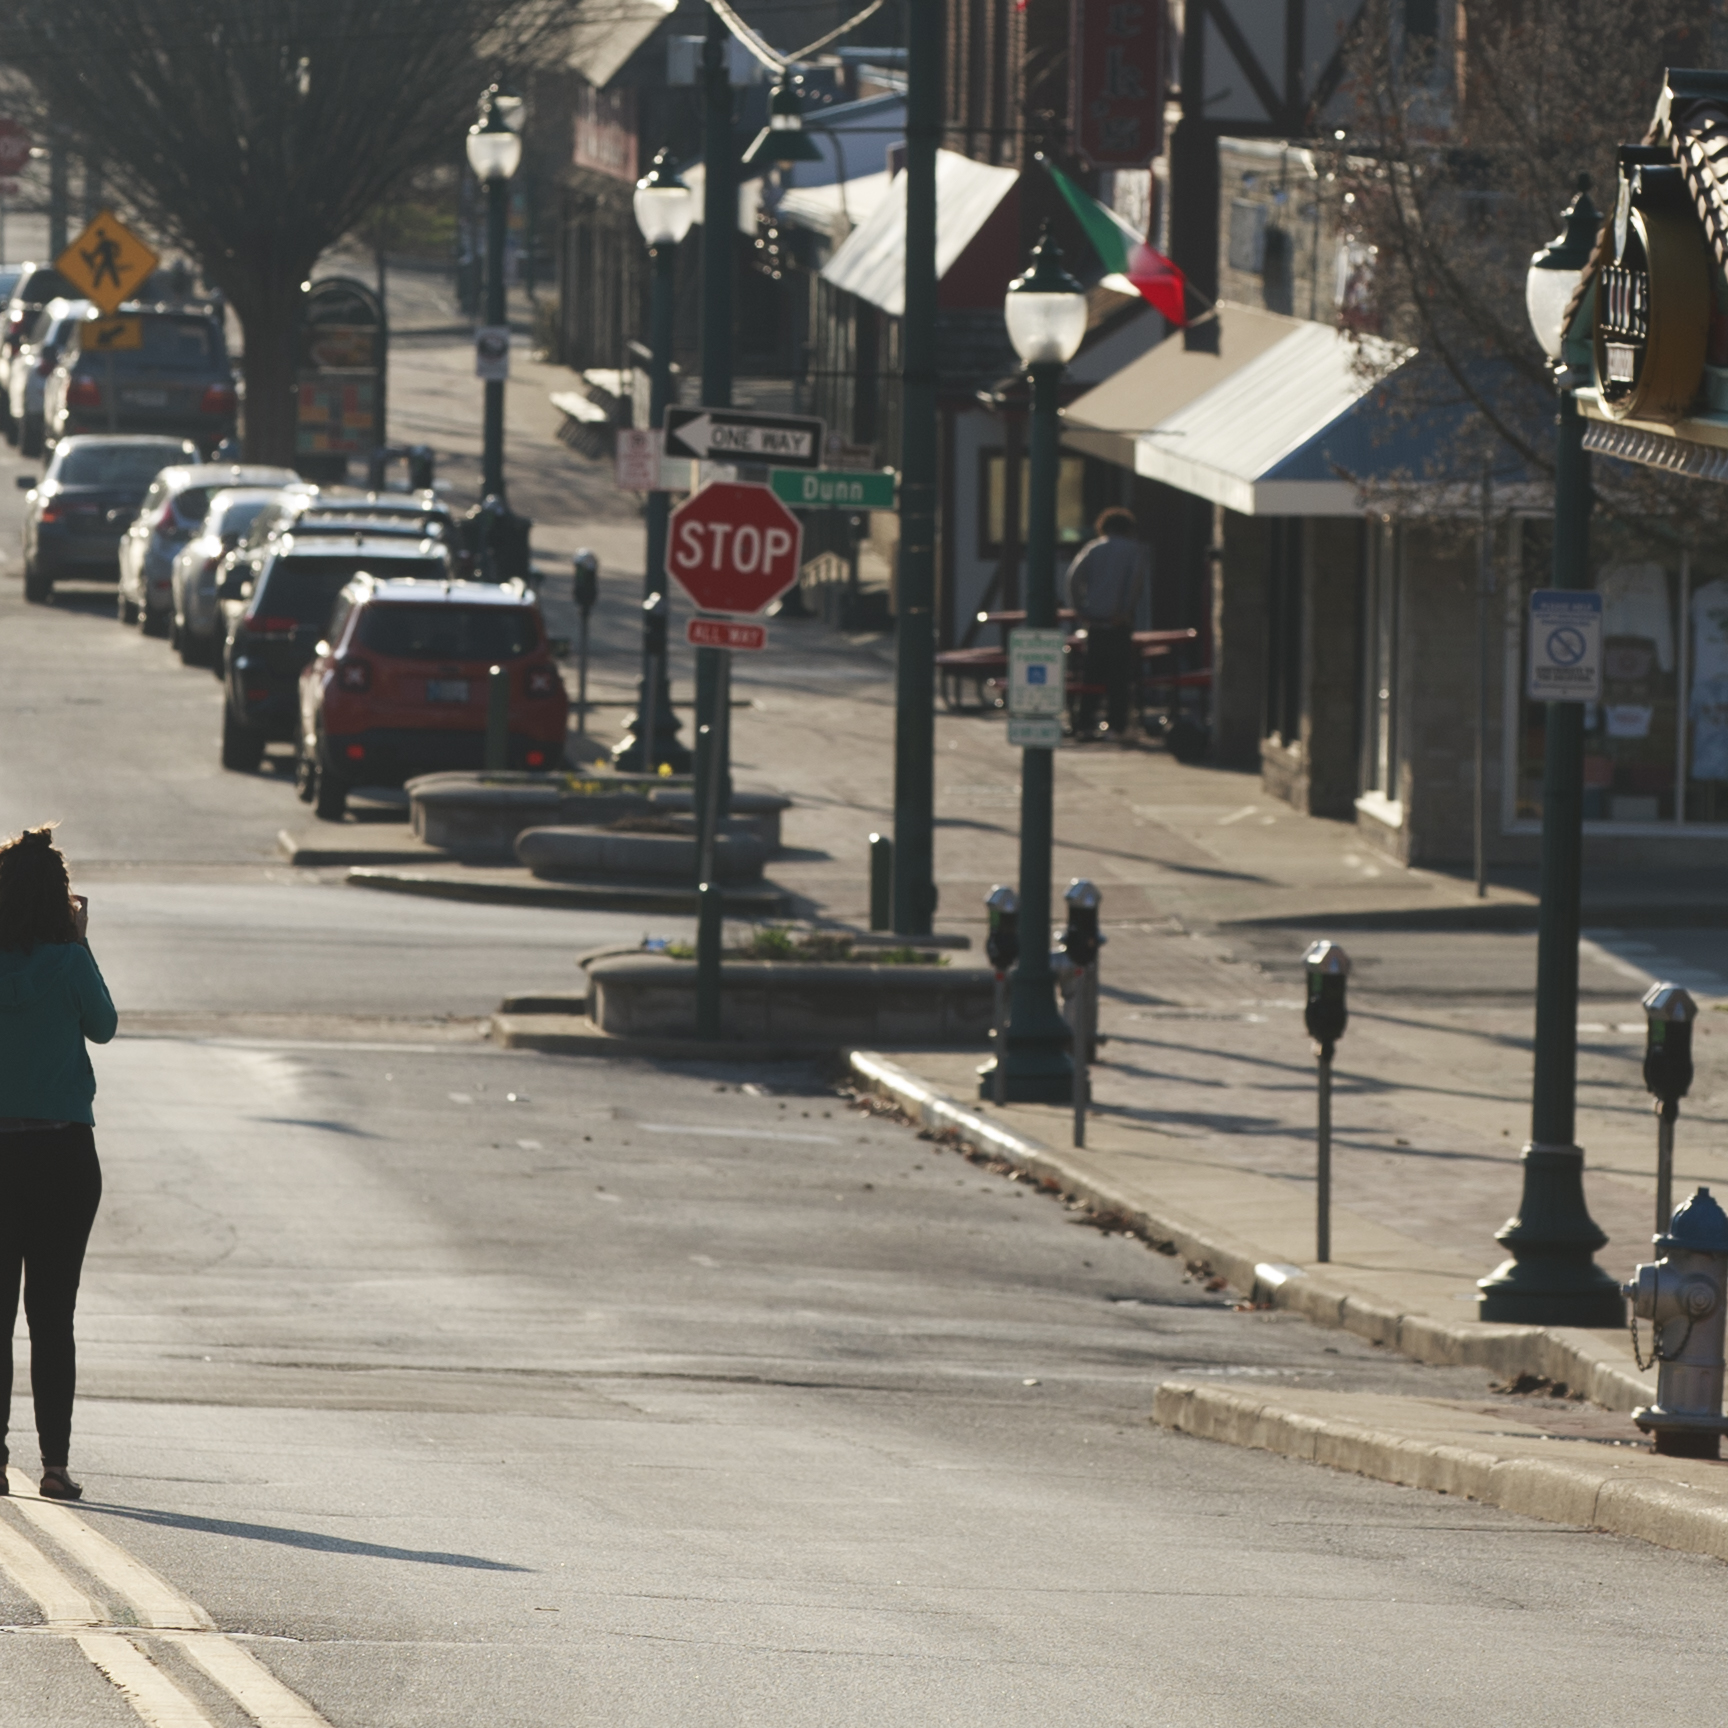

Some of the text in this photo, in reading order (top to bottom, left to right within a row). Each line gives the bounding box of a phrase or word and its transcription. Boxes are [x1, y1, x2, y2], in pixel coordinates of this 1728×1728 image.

[712, 426, 807, 451] ONE WAY
[803, 475, 864, 501] Dunn
[675, 519, 793, 576] STOP
